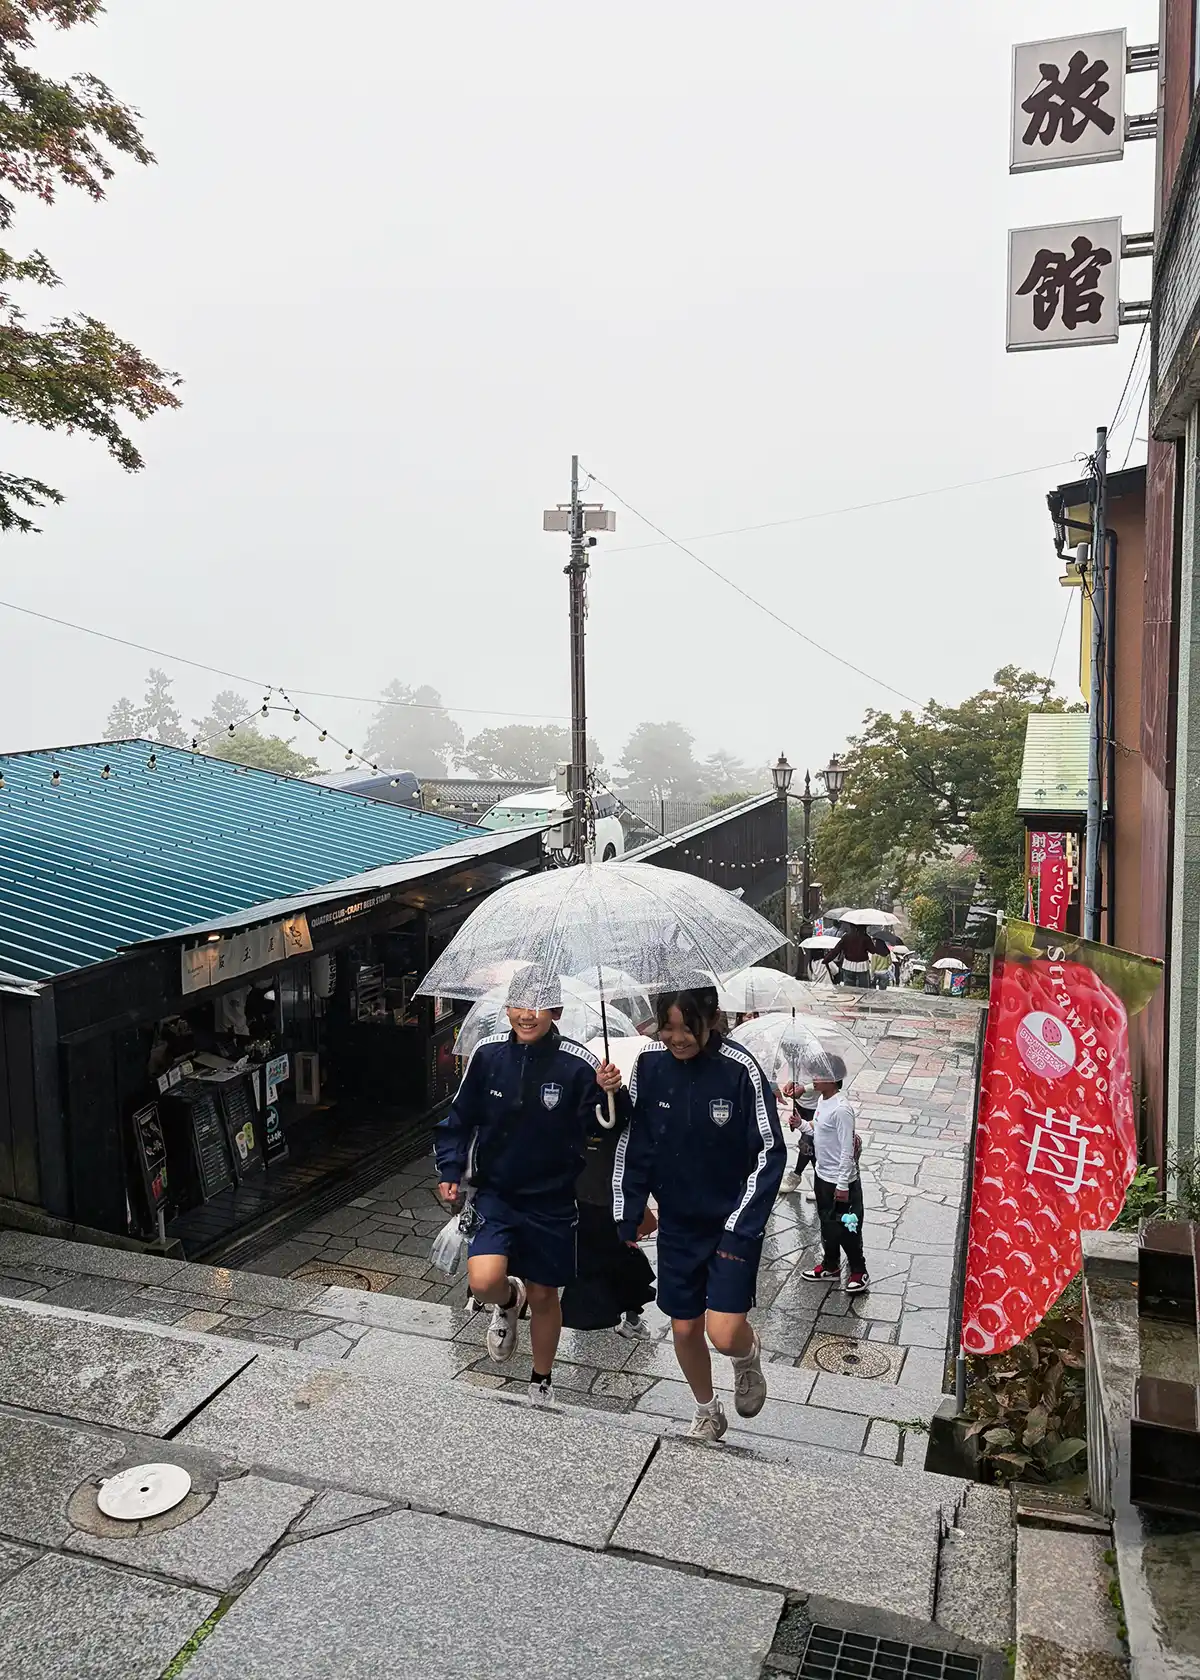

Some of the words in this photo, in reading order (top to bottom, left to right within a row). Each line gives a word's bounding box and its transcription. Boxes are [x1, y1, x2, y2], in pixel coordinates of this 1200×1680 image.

[1021, 50, 1116, 146] 旅
[1015, 235, 1113, 331] 館
[1031, 833, 1047, 863] 射的
[311, 912, 333, 928] QUATRE
[363, 898, 376, 909] BEER
[1047, 945, 1116, 1070] Strawber
[1019, 1027, 1067, 1073] STRAWBERRY
[1025, 1046, 1047, 1070] BOMB
[1074, 1056, 1109, 1092] Bo
[658, 1101, 671, 1109] FILA
[1019, 1107, 1104, 1194] 苺
